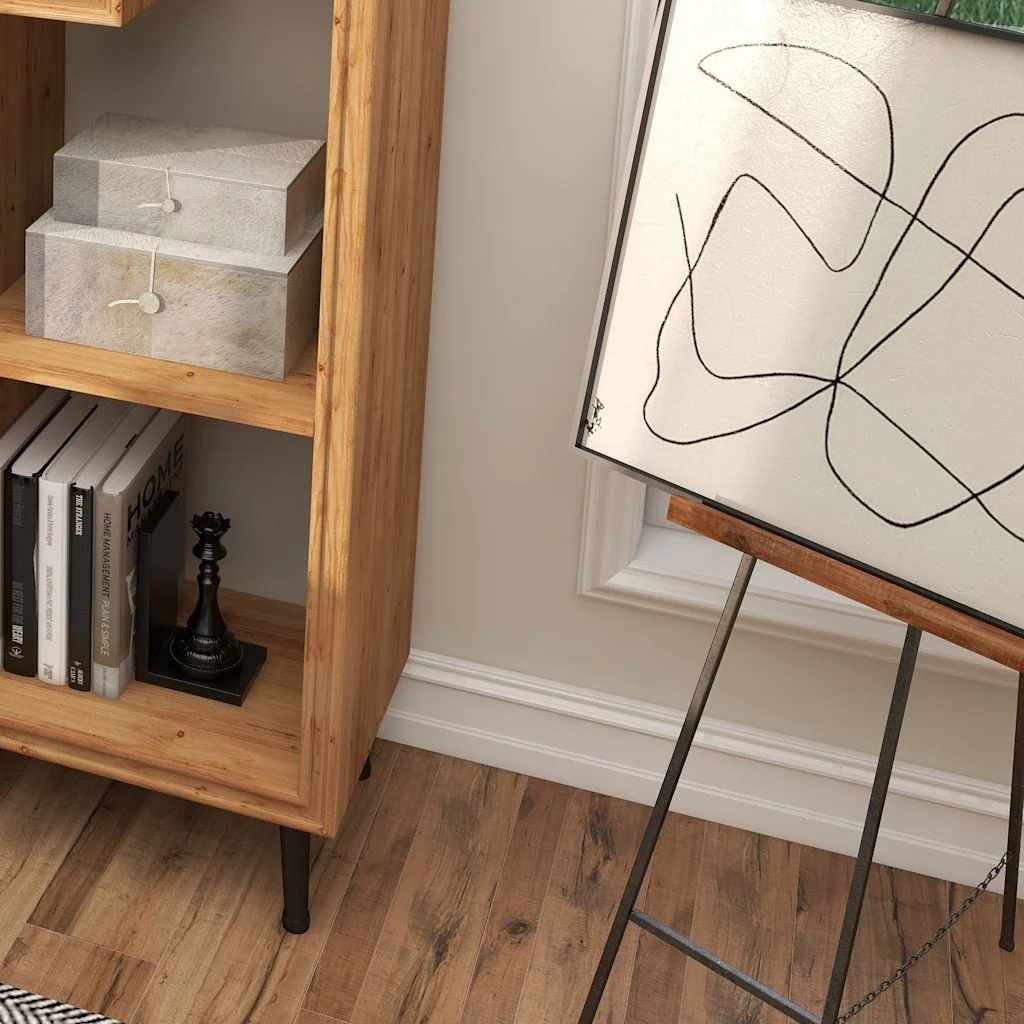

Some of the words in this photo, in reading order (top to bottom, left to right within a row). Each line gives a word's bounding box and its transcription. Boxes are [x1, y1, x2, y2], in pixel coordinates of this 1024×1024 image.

[75, 494, 83, 507] THE
[75, 506, 83, 536] STRANGER
[103, 512, 112, 537] HOME
[101, 538, 111, 598] MANAGEMENT
[101, 600, 110, 622] PLAIN
[100, 629, 110, 656] SIMPLE
